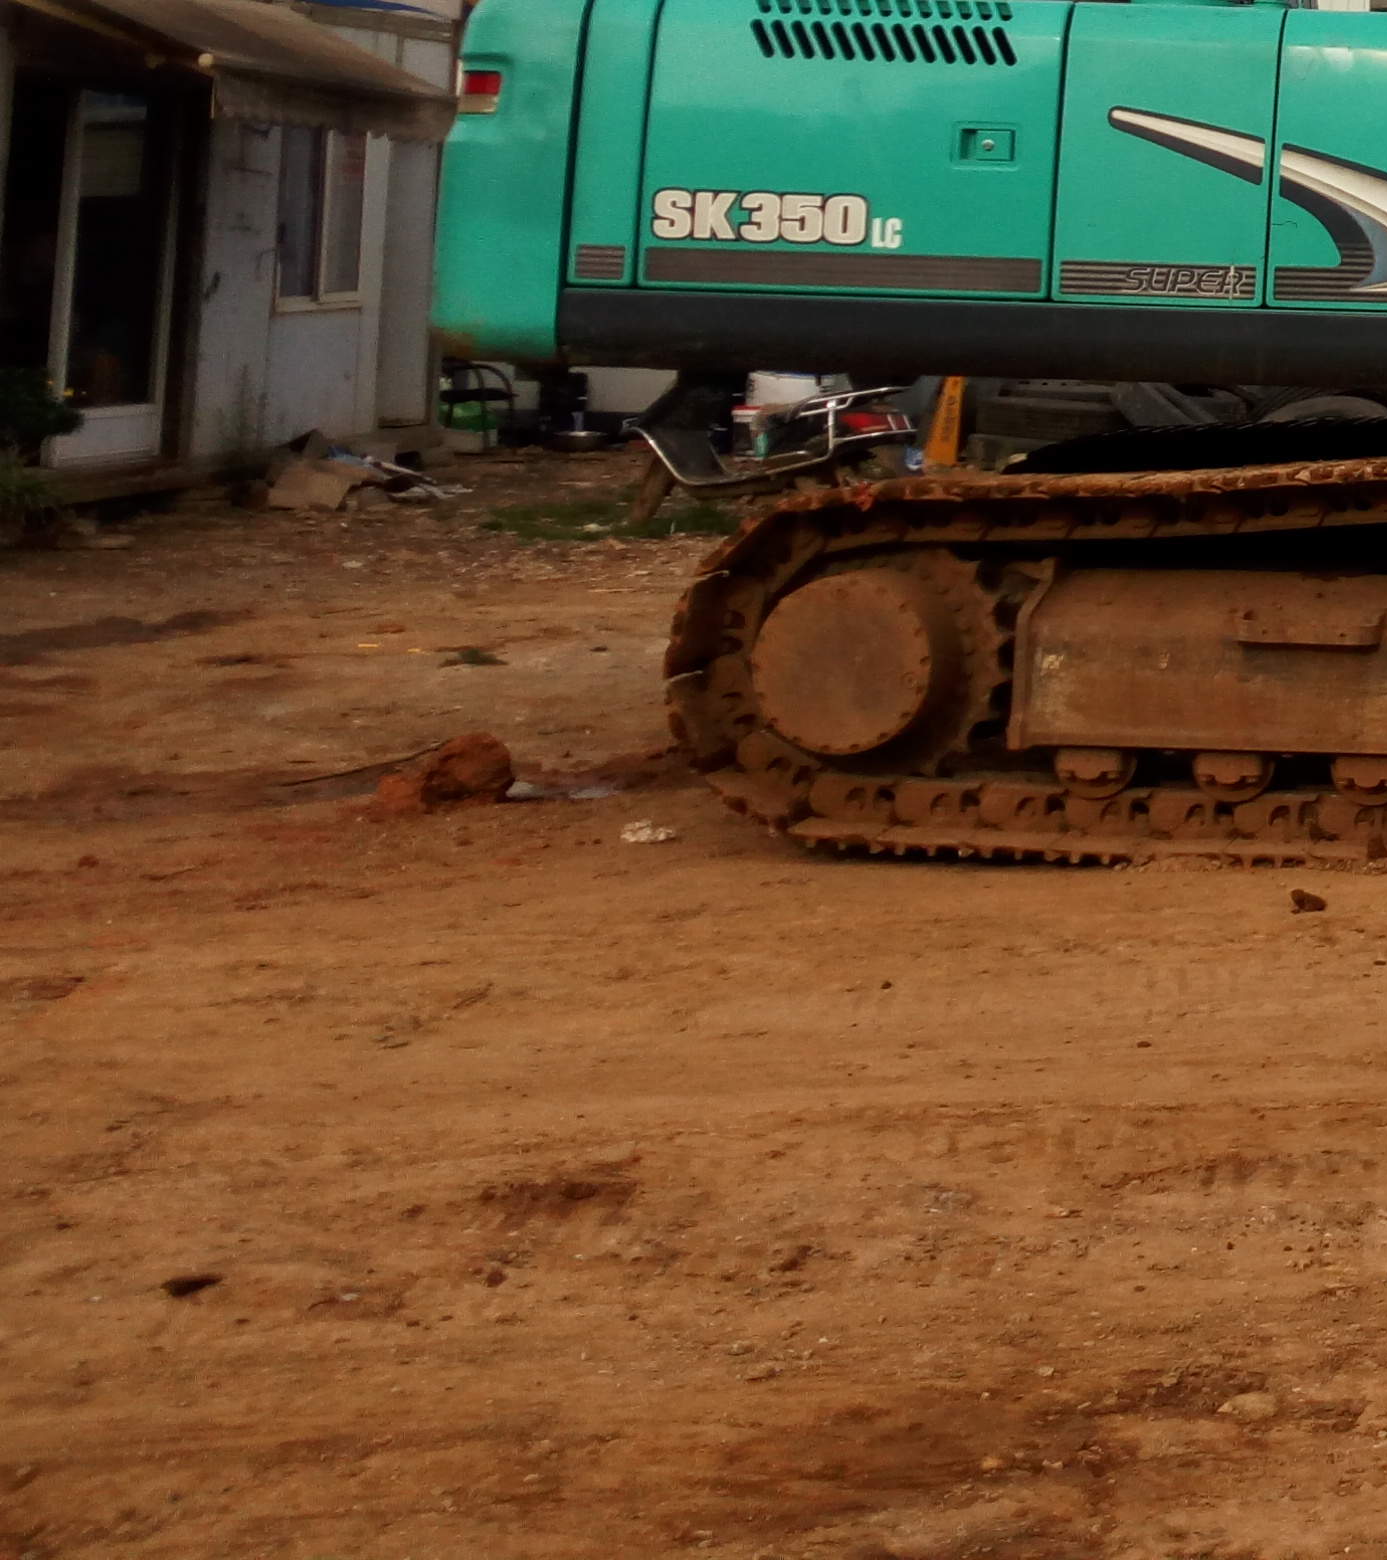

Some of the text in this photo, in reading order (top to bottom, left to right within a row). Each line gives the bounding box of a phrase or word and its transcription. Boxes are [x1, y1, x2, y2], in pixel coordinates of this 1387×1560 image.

[652, 188, 904, 249] SK350 LC
[1122, 267, 1246, 297] SUPER
